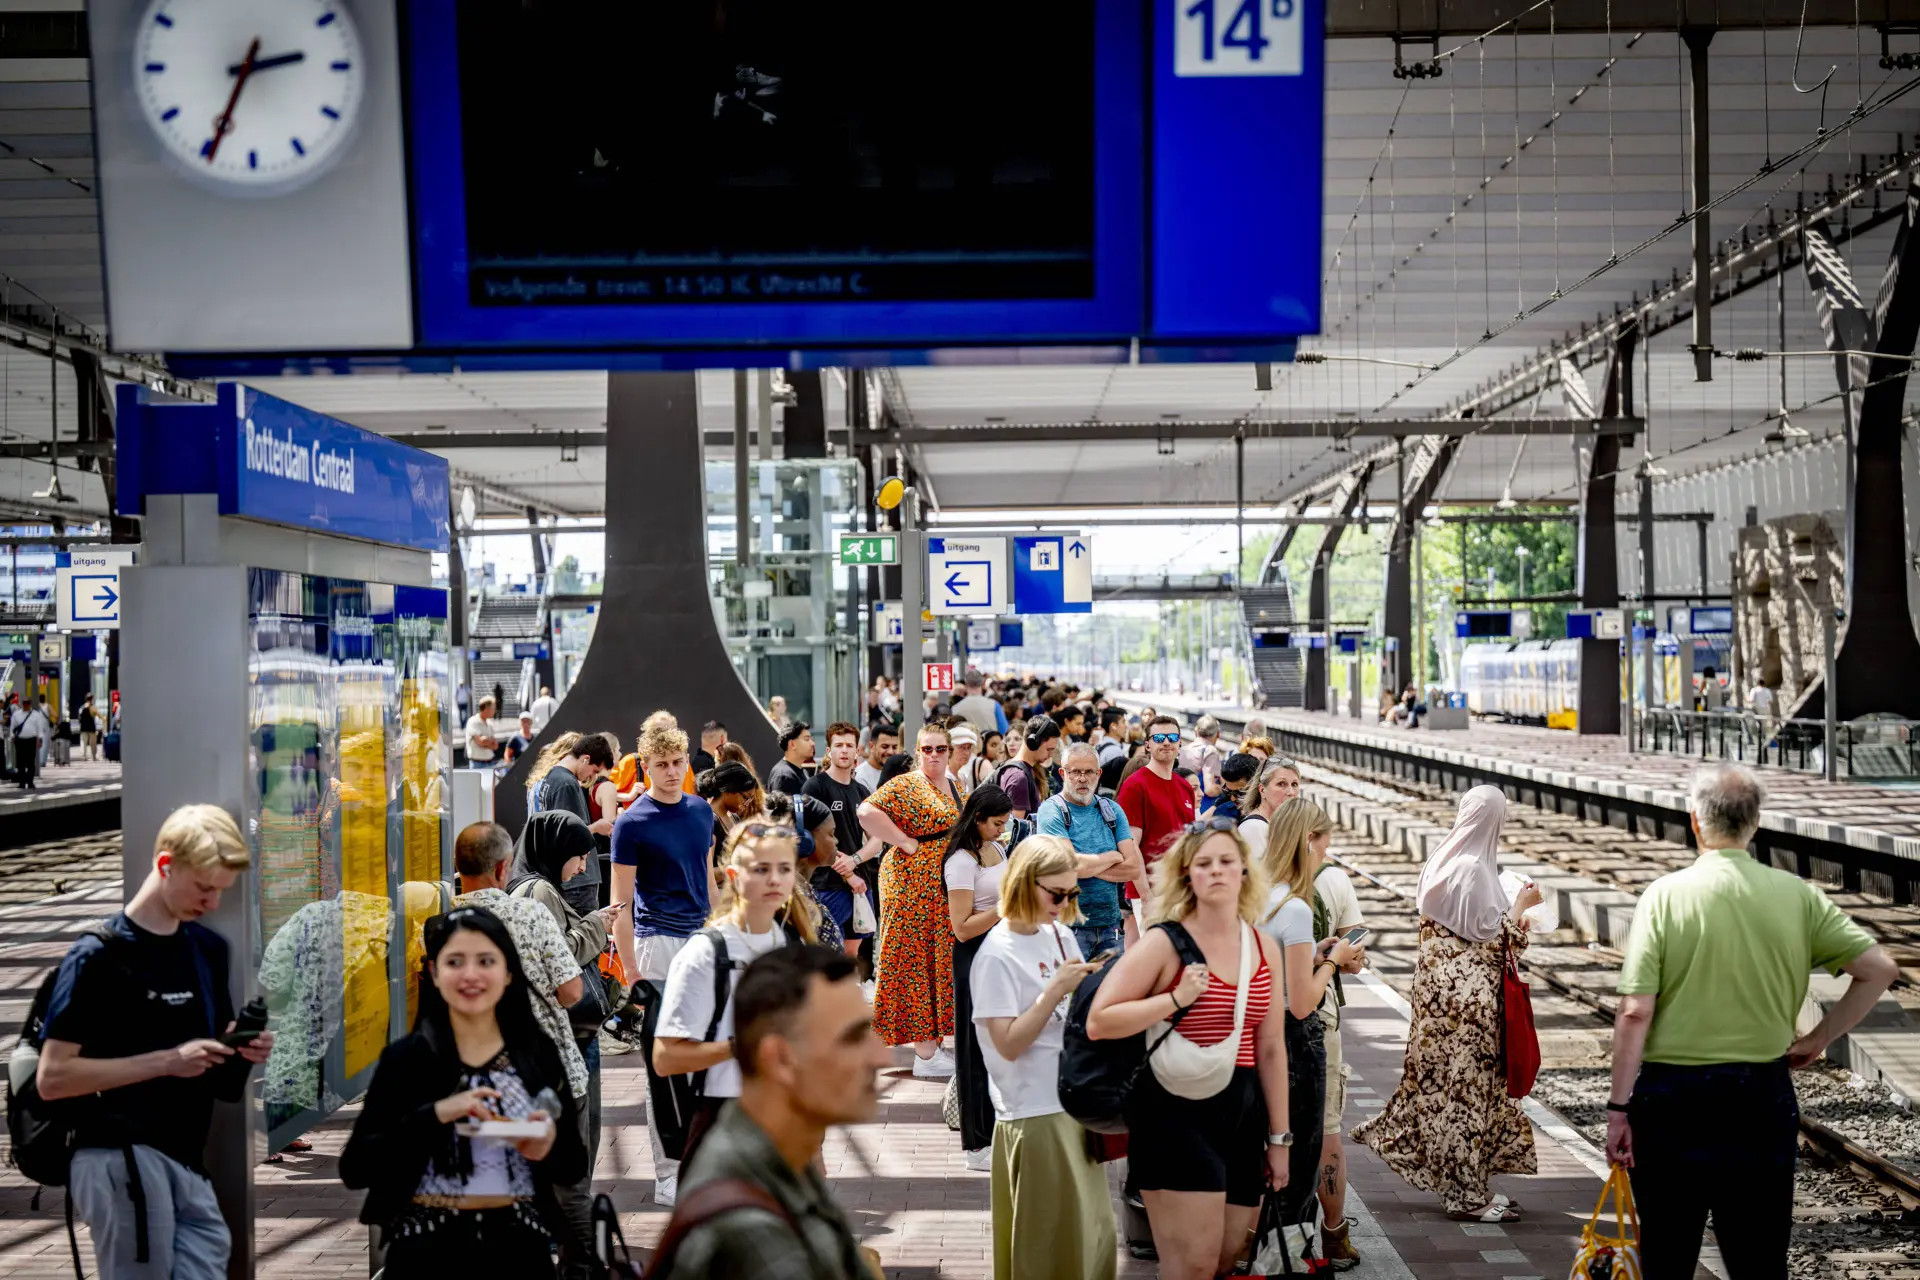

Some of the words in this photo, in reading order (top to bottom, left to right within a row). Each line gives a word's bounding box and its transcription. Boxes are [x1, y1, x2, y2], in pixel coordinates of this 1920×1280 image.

[245, 418, 310, 483] Rotterdam
[312, 439, 355, 495] Centraal
[947, 543, 980, 552] uitgang
[73, 557, 106, 567] uitgang
